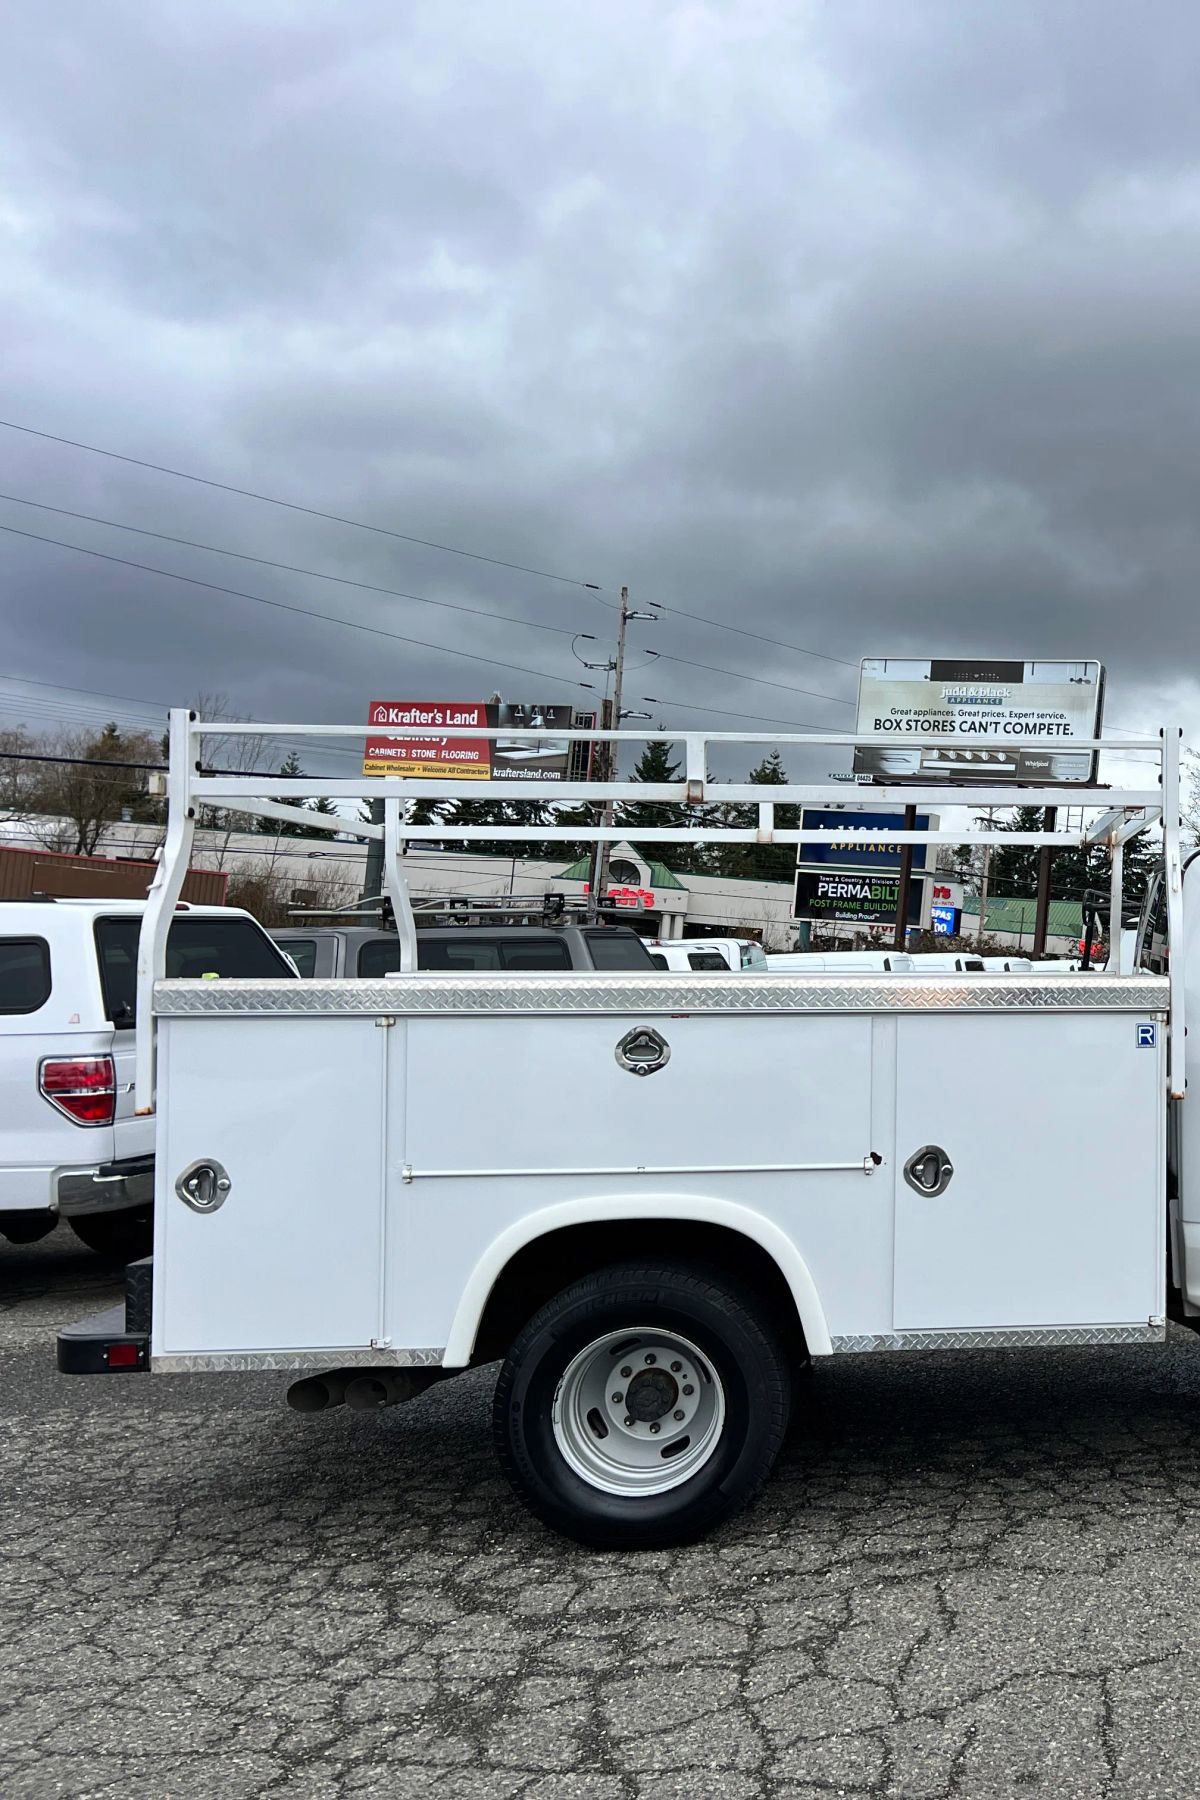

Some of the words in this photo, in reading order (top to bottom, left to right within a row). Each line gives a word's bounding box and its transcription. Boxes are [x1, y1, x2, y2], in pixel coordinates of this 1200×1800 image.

[940, 686, 966, 699] judd
[968, 687, 979, 697] &
[980, 687, 1011, 698] black
[949, 697, 1001, 705] APPLIANCE
[389, 708, 442, 723] Krafter's
[446, 709, 478, 725] Land
[890, 707, 912, 716] Great
[913, 708, 955, 718] appliances.
[958, 709, 980, 717] Great
[982, 710, 1007, 719] prices.
[1009, 711, 1034, 720] Expert
[1036, 712, 1066, 720] service.
[874, 718, 903, 731] BOX
[905, 719, 956, 732] STORES
[959, 720, 1000, 734] CAN'T
[1003, 722, 1074, 736] COMPETE.
[368, 747, 407, 757] CABINETS
[411, 749, 437, 758] STONE
[441, 750, 479, 760] FLOORING
[386, 764, 416, 772] Wholesaler
[422, 765, 447, 773] Welcome
[456, 767, 489, 776] Contractors
[1024, 760, 1049, 769] Whirlpool
[492, 767, 561, 780] kraftersland.com
[830, 842, 902, 854] APPLIANCE
[871, 878, 893, 886] Division
[818, 882, 900, 901] PERMABILT
[809, 898, 831, 908] POST
[833, 900, 861, 910] FRAME
[864, 903, 897, 912] BUILDIN
[835, 911, 858, 921] Building
[931, 908, 952, 921] SPAS
[1138, 1026, 1154, 1044] R
